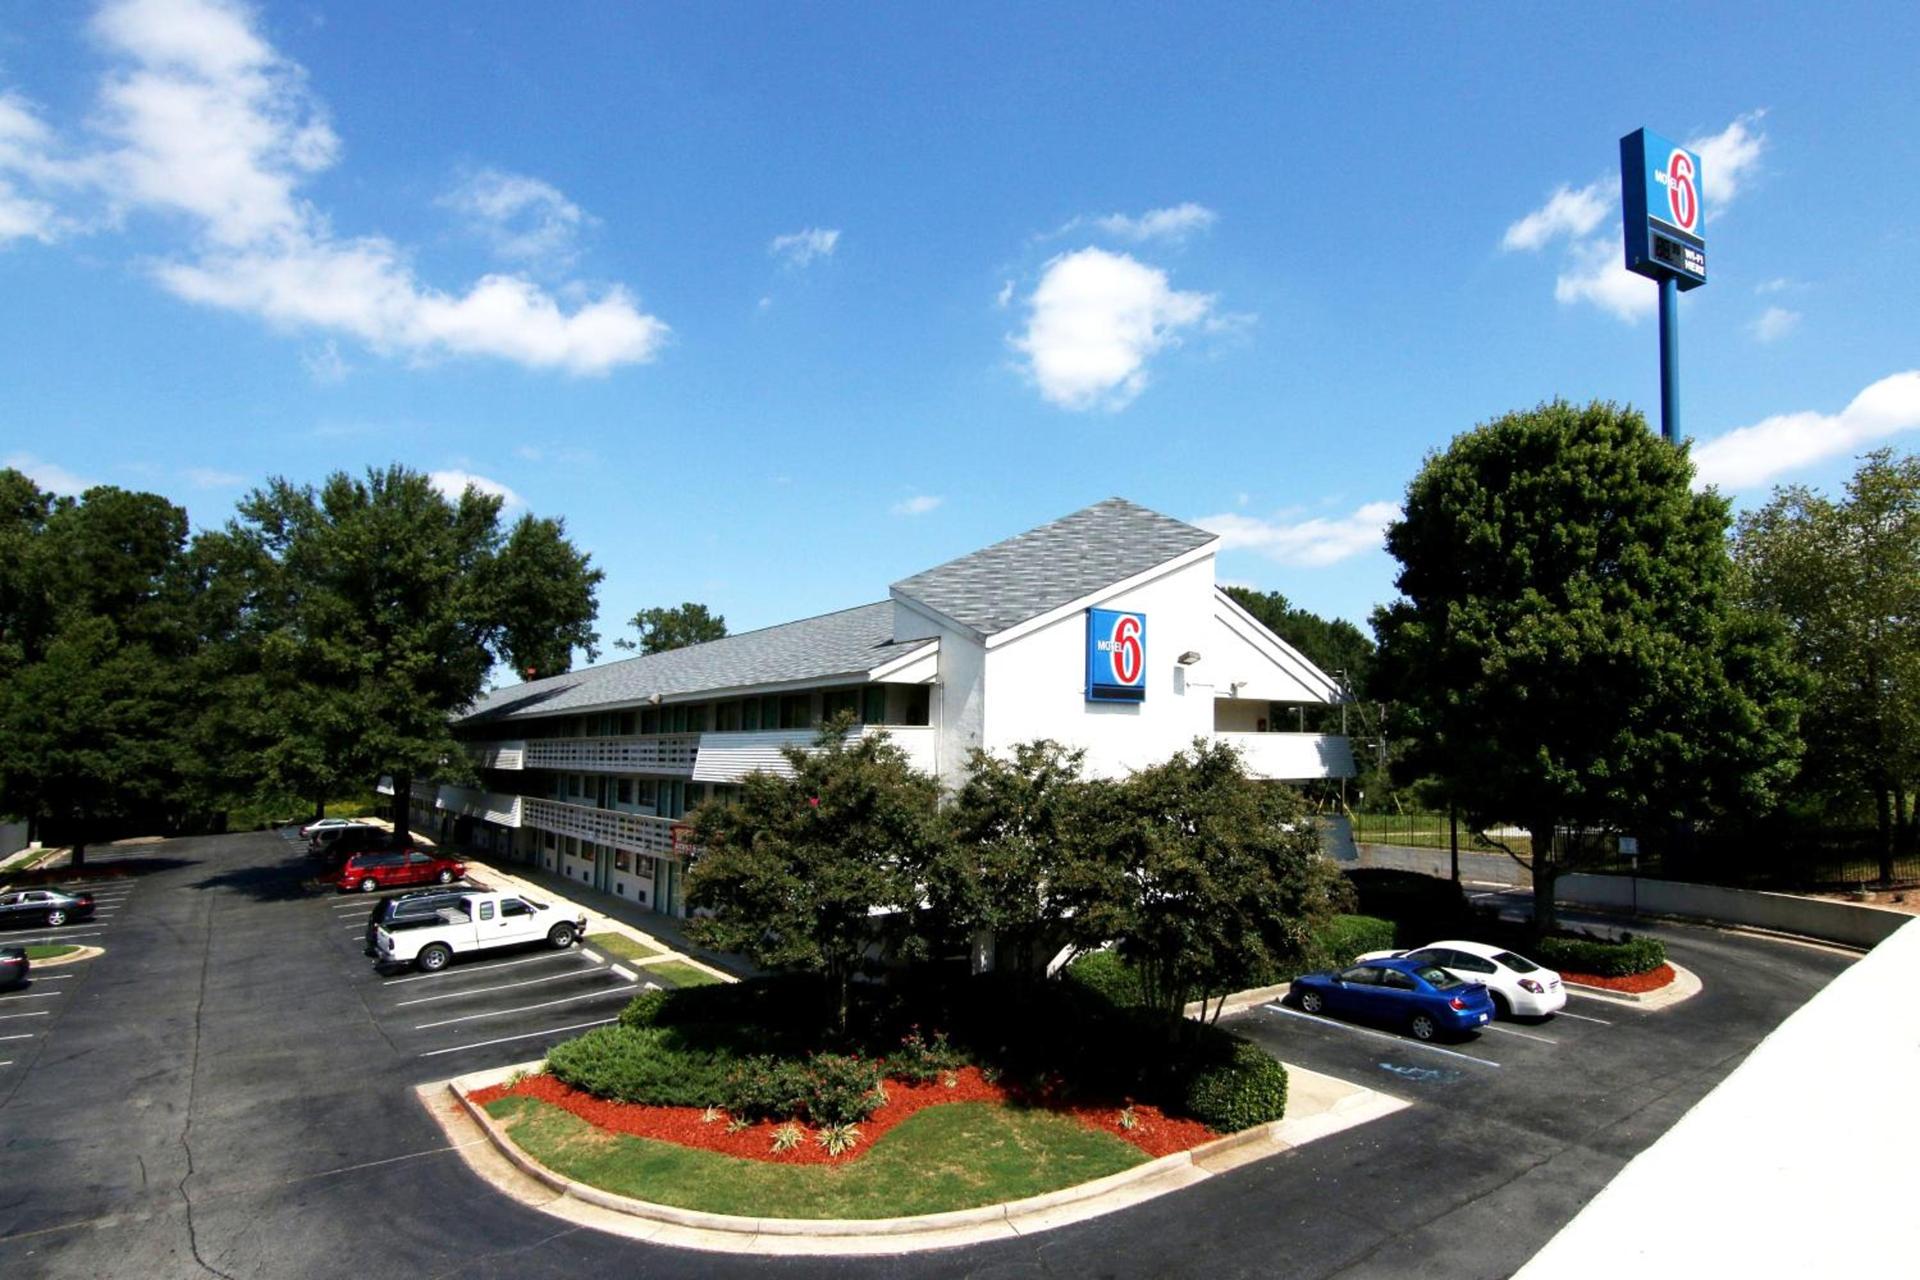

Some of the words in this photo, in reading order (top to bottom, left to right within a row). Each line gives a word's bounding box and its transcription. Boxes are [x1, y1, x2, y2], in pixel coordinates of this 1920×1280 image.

[1669, 150, 1697, 230] 6
[1097, 640, 1123, 652] MOTEL
[1112, 615, 1142, 685] 6
